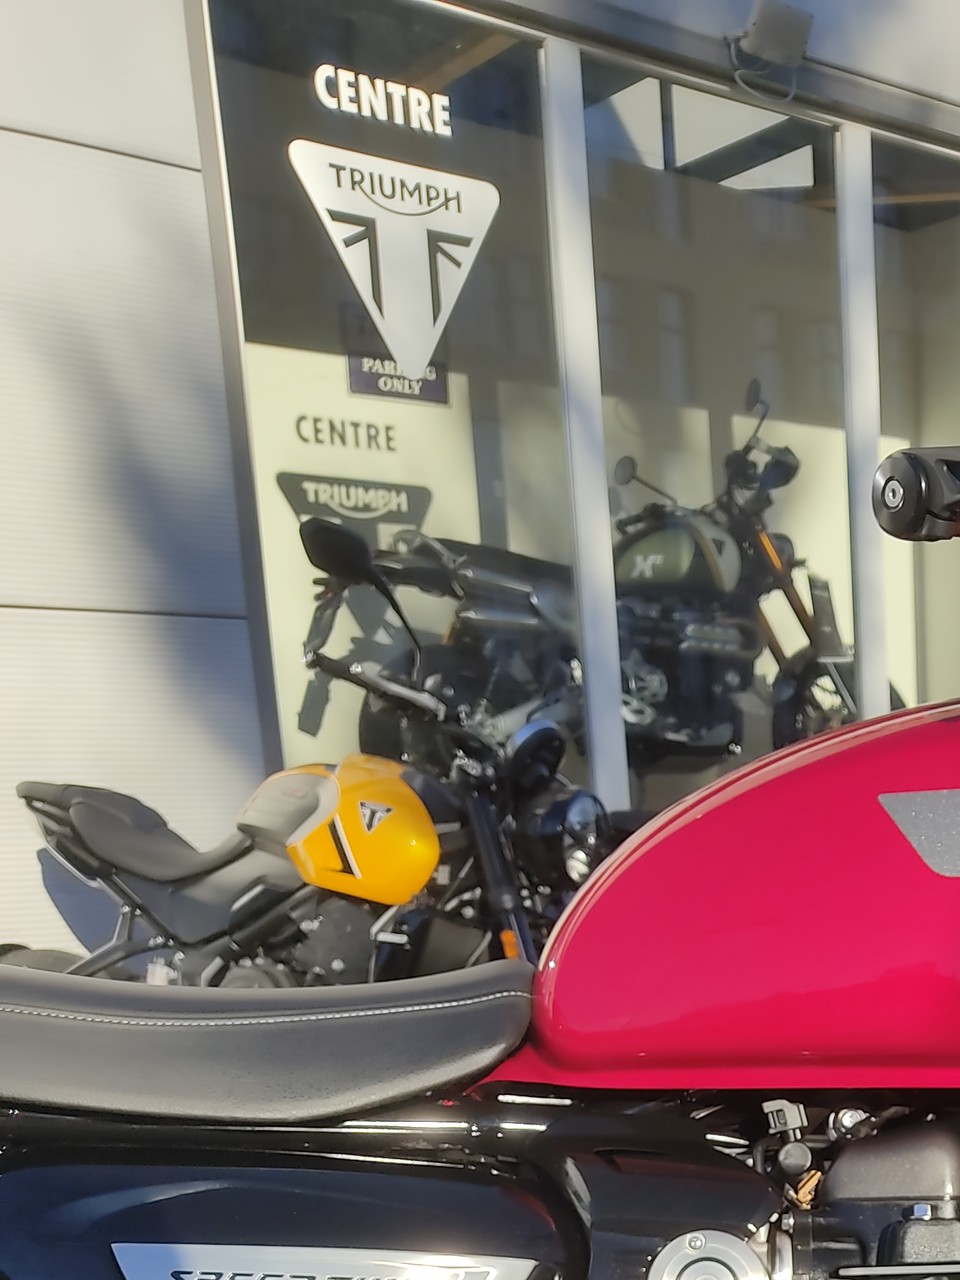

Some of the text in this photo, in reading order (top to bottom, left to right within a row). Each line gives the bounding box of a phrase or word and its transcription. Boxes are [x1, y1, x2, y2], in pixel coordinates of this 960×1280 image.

[313, 63, 453, 137] CENTRE
[328, 162, 463, 217] TRIUMPH
[361, 356, 438, 381] PARG
[377, 375, 422, 395] ONLY
[295, 415, 397, 452] CENTRE
[301, 480, 409, 520] TRIUMPH
